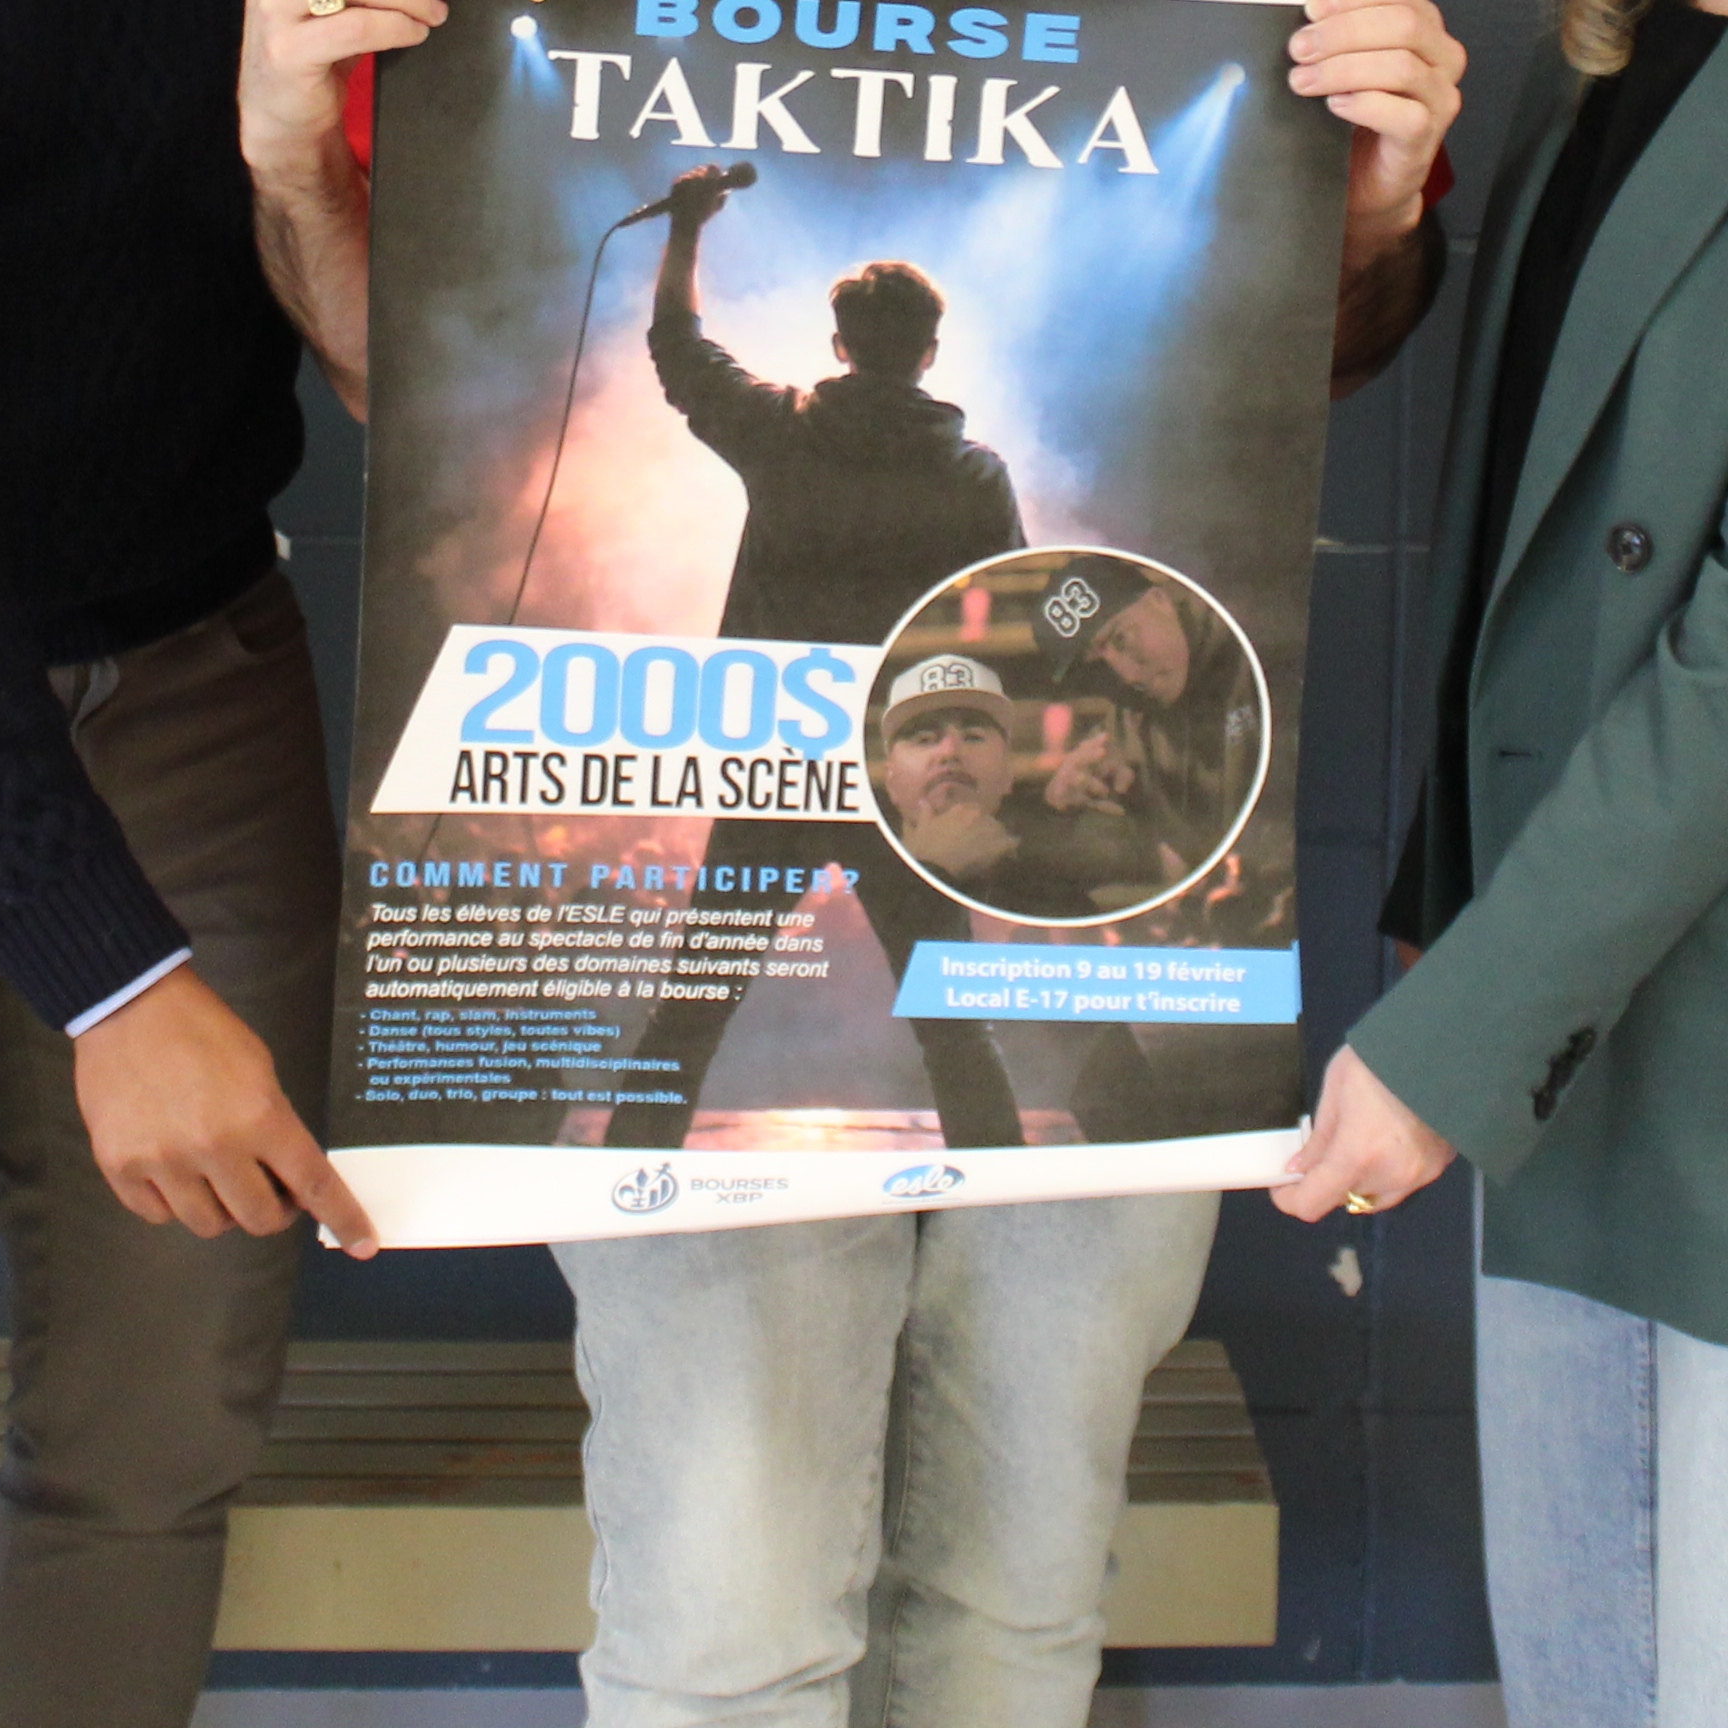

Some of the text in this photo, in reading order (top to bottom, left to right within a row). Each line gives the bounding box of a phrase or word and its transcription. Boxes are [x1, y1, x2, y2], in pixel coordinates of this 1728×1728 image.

[547, 49, 1160, 174] TAKTIKA
[1045, 578, 1100, 638] 83
[921, 664, 974, 693] 83
[460, 639, 857, 761] 2000$
[449, 747, 860, 813] ARTS DE LA SCÈNE
[369, 861, 568, 888] COMMENT
[371, 903, 814, 930] Tous les élèves de l'ESLE qui présentent une
[366, 928, 824, 954] performance au spectacle de fin d'année dans
[366, 954, 829, 979] l'un ou plusieurs des domaines suivants seront
[941, 956, 1247, 984] Inscription 9 au 19 février
[365, 979, 539, 1002] automatiquement
[543, 978, 612, 1002] éligible
[617, 980, 631, 998] à
[636, 980, 654, 998] la
[659, 981, 729, 1001] bourse
[945, 987, 1009, 1009] Local
[1015, 989, 1068, 1010] E-17
[1074, 993, 1132, 1015] pour
[505, 1009, 597, 1021] instruments
[369, 1025, 417, 1037] Danse
[521, 1025, 568, 1037] toutes
[502, 1040, 527, 1054] jeu
[531, 1040, 602, 1055] scénique
[367, 1057, 474, 1071] Performances
[370, 1073, 511, 1086] ou expérimentales
[482, 1090, 537, 1103] groupe
[550, 1089, 583, 1102] tout
[587, 1090, 612, 1103] est
[690, 1177, 789, 1192] BOURSES
[889, 1165, 958, 1195] esle
[716, 1192, 763, 1204] XBP
